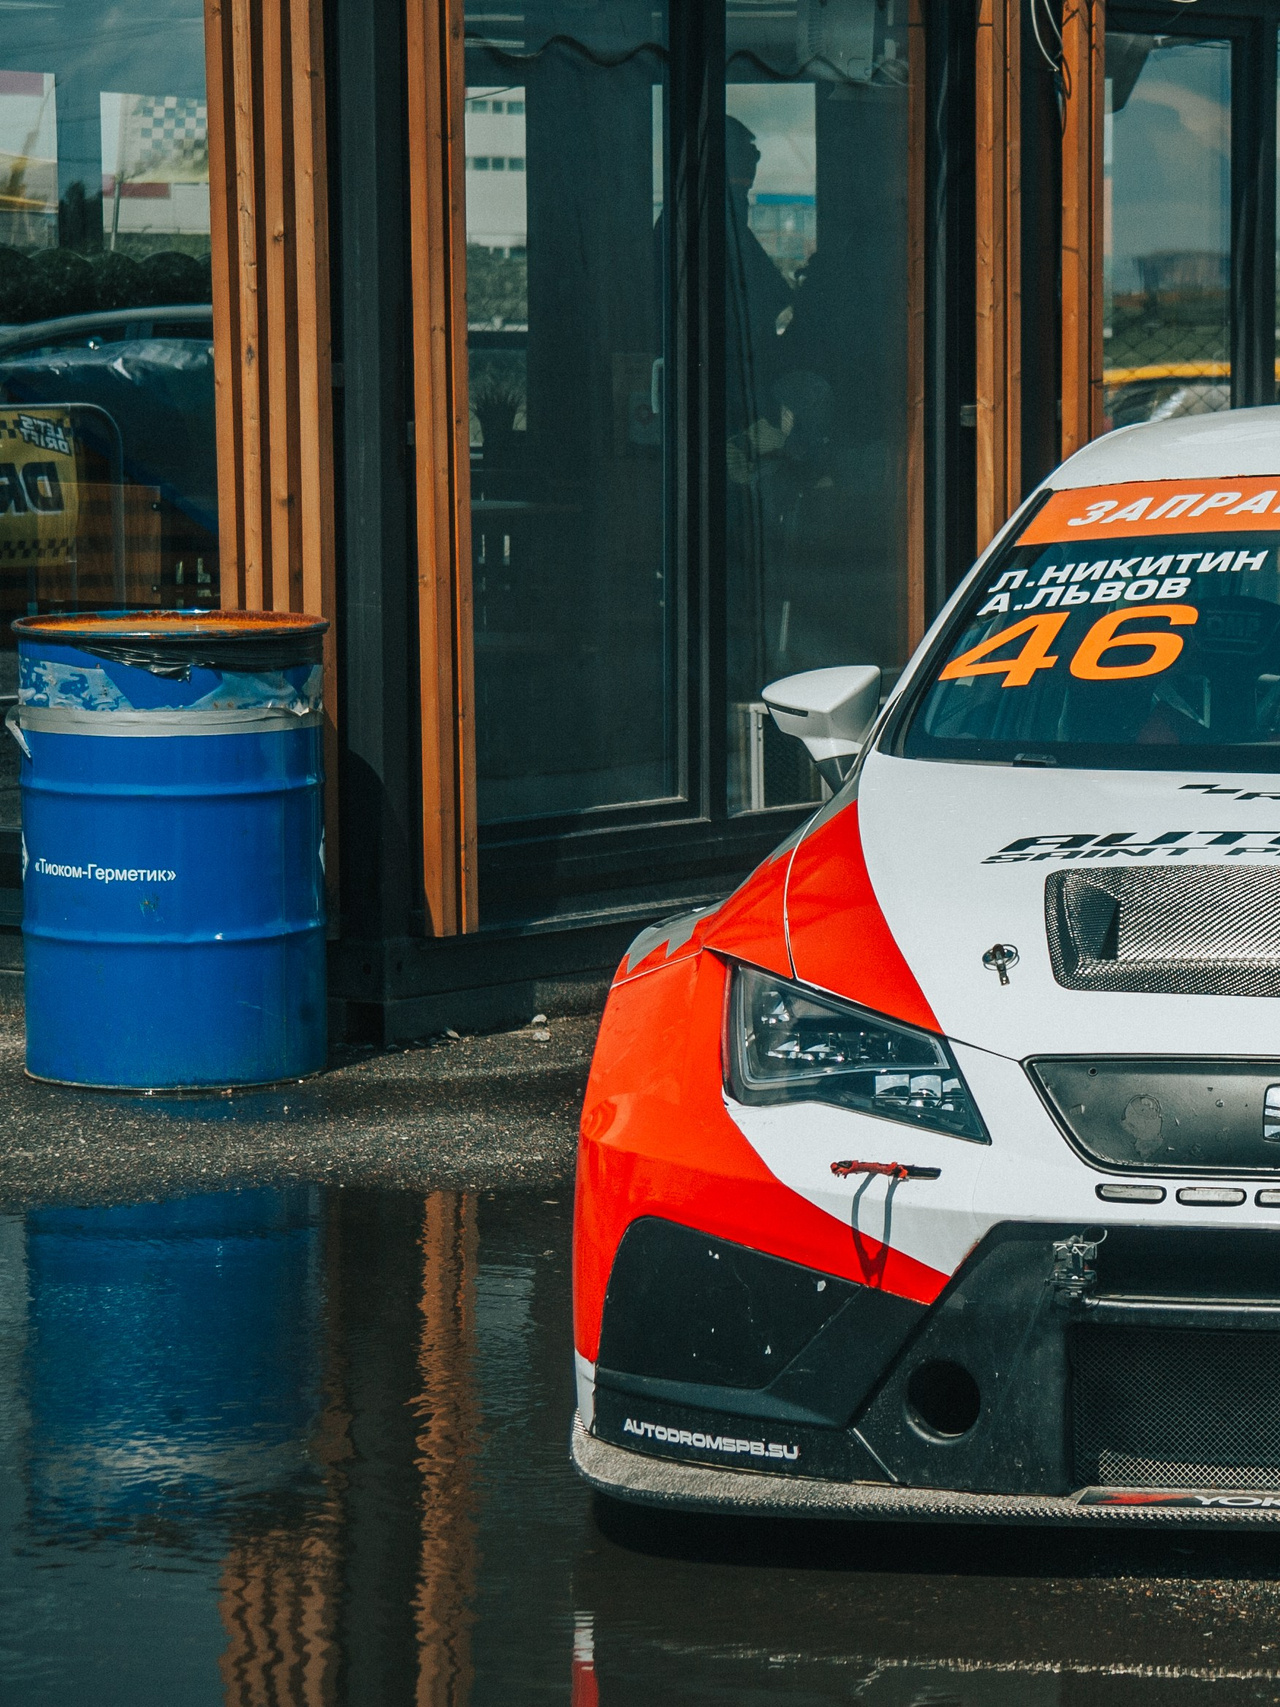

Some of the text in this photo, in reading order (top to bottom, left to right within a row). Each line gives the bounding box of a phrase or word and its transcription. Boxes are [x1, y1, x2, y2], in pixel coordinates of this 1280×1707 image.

[988, 550, 1269, 593] Л.НИКИТИН
[976, 577, 1192, 616] А.ЛЬВОВ
[938, 604, 1199, 688] 46
[34, 858, 177, 884] «Тиоком-Герметик»
[980, 846, 1209, 864] SAINT
[623, 1417, 799, 1460] AUTODROMSPB.SU
